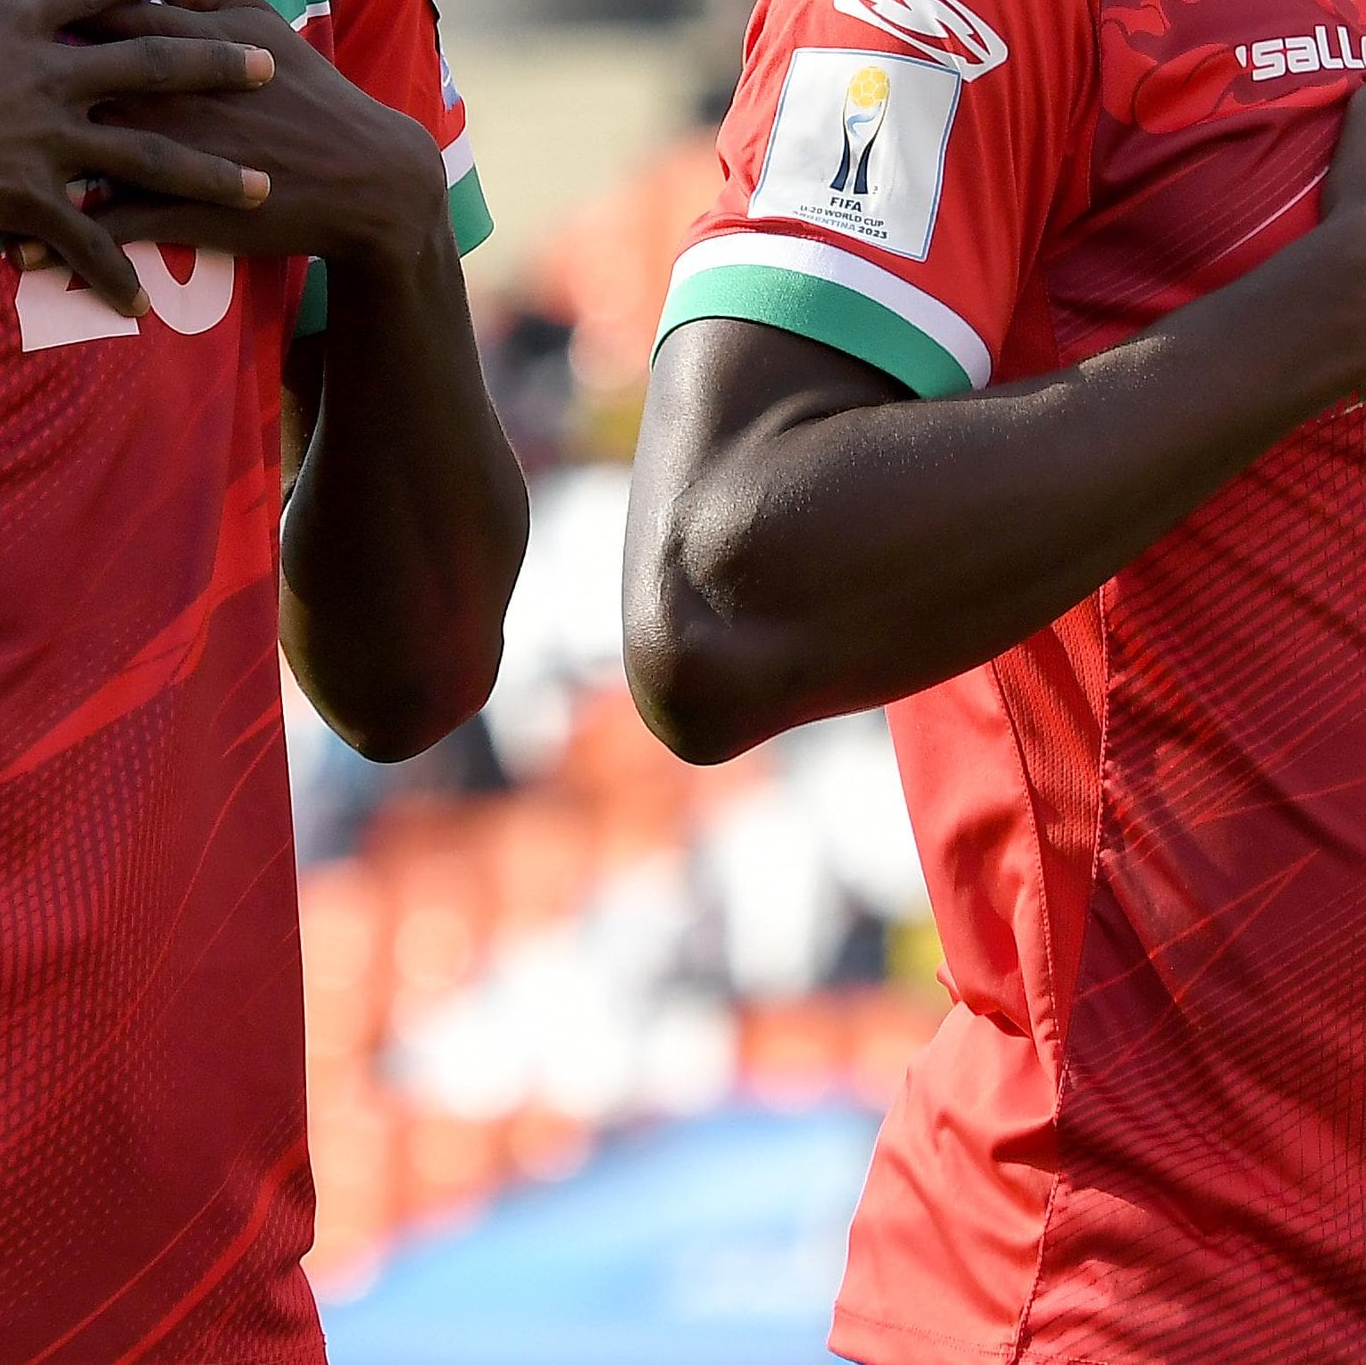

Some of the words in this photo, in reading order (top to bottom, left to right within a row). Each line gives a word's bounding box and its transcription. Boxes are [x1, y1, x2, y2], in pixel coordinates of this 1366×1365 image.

[830, 196, 862, 213] FIFA
[824, 208, 862, 223] WORLD
[863, 217, 885, 227] CUP
[857, 226, 888, 240] 2023
